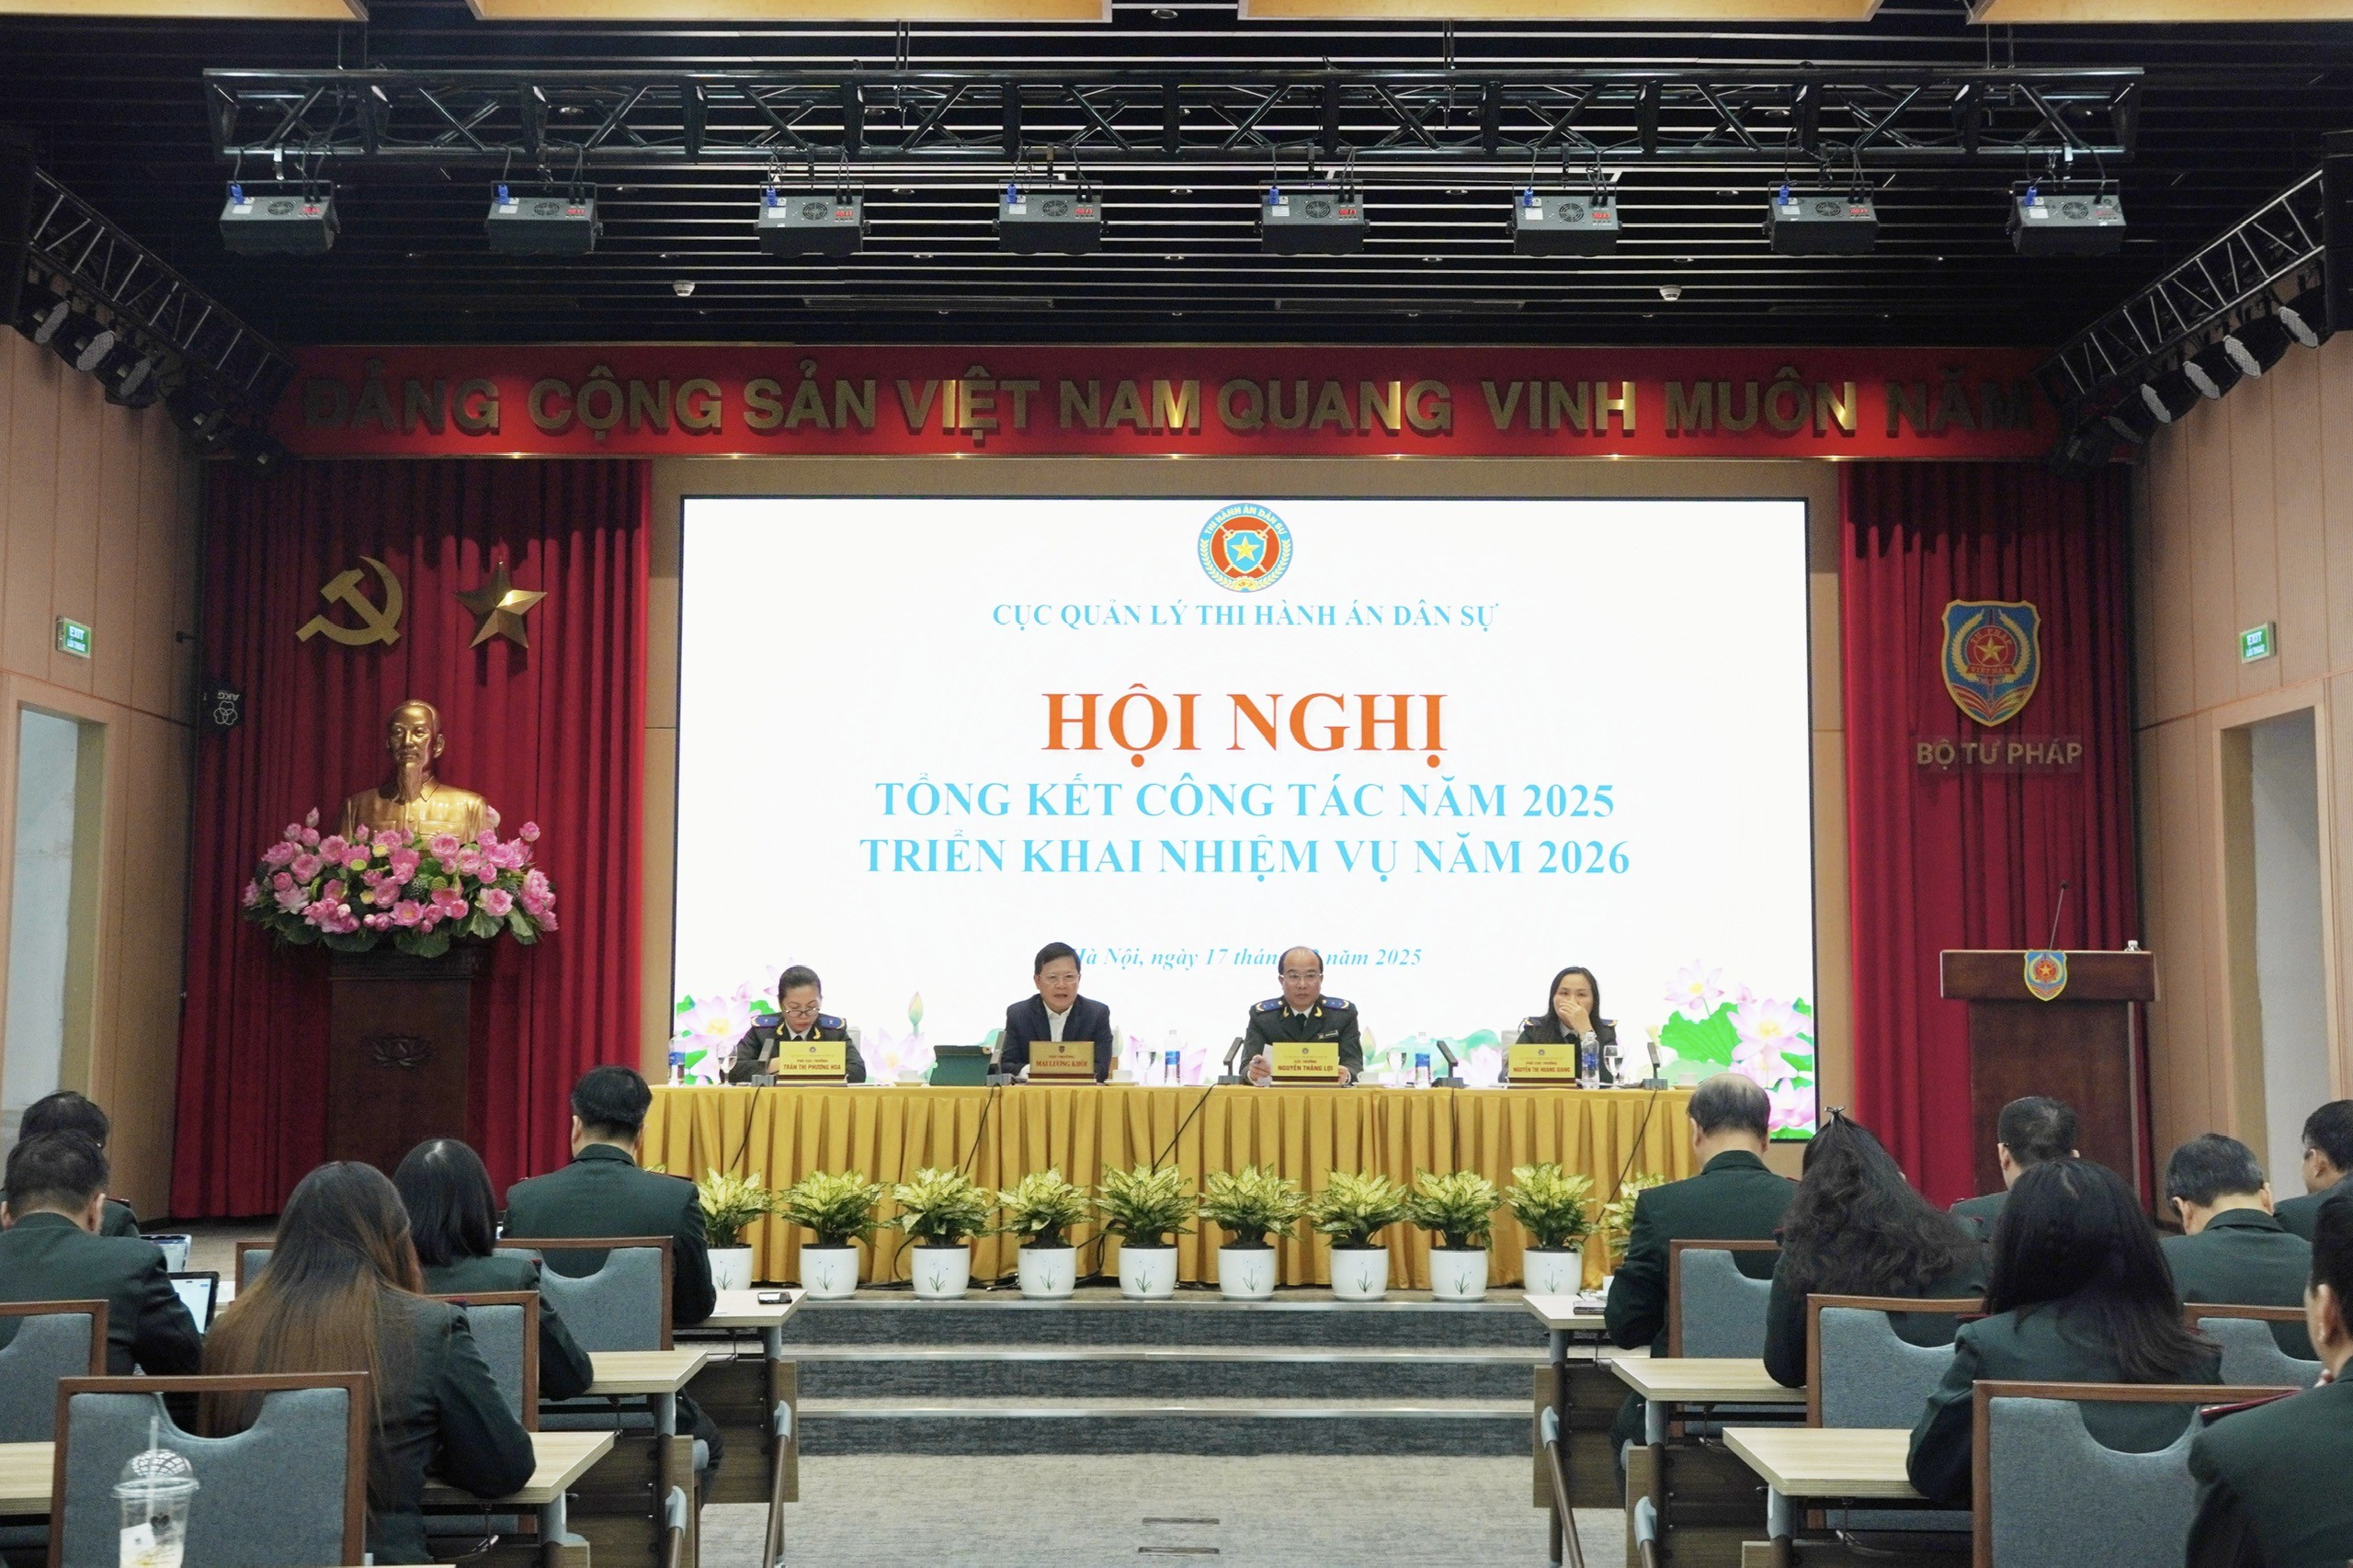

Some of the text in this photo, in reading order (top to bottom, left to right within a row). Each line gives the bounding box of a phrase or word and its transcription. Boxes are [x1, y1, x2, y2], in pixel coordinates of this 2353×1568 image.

[303, 359, 2034, 441] ĐẢNG CỘNG SẢN VIỆT NAM QUANG VINH MUÔN NĂM
[1204, 521, 1217, 534] THI
[993, 599, 1499, 632] CỤC QUẢN LÝ THI HÀNH ÁN DÂN SỰ
[69, 625, 85, 641] EXIT
[2246, 631, 2262, 645] EXIT
[217, 691, 240, 701] AKG
[1041, 683, 1448, 768] HỘI NGHỊ
[1916, 737, 2083, 770] BỘ TƯ PHÁP
[875, 772, 1615, 818] TỔNG KẾT CÔNG TÁC NĂM 2025
[860, 829, 1630, 883] TRIỂN KHAI NHIỆM VỤ NĂM 2026
[1103, 948, 1144, 971] Nội,
[1151, 948, 1198, 971] ngày
[1205, 949, 1229, 965] 17
[1233, 948, 1278, 965] thán
[1325, 950, 1369, 966] năm
[1375, 949, 1423, 966] 2025
